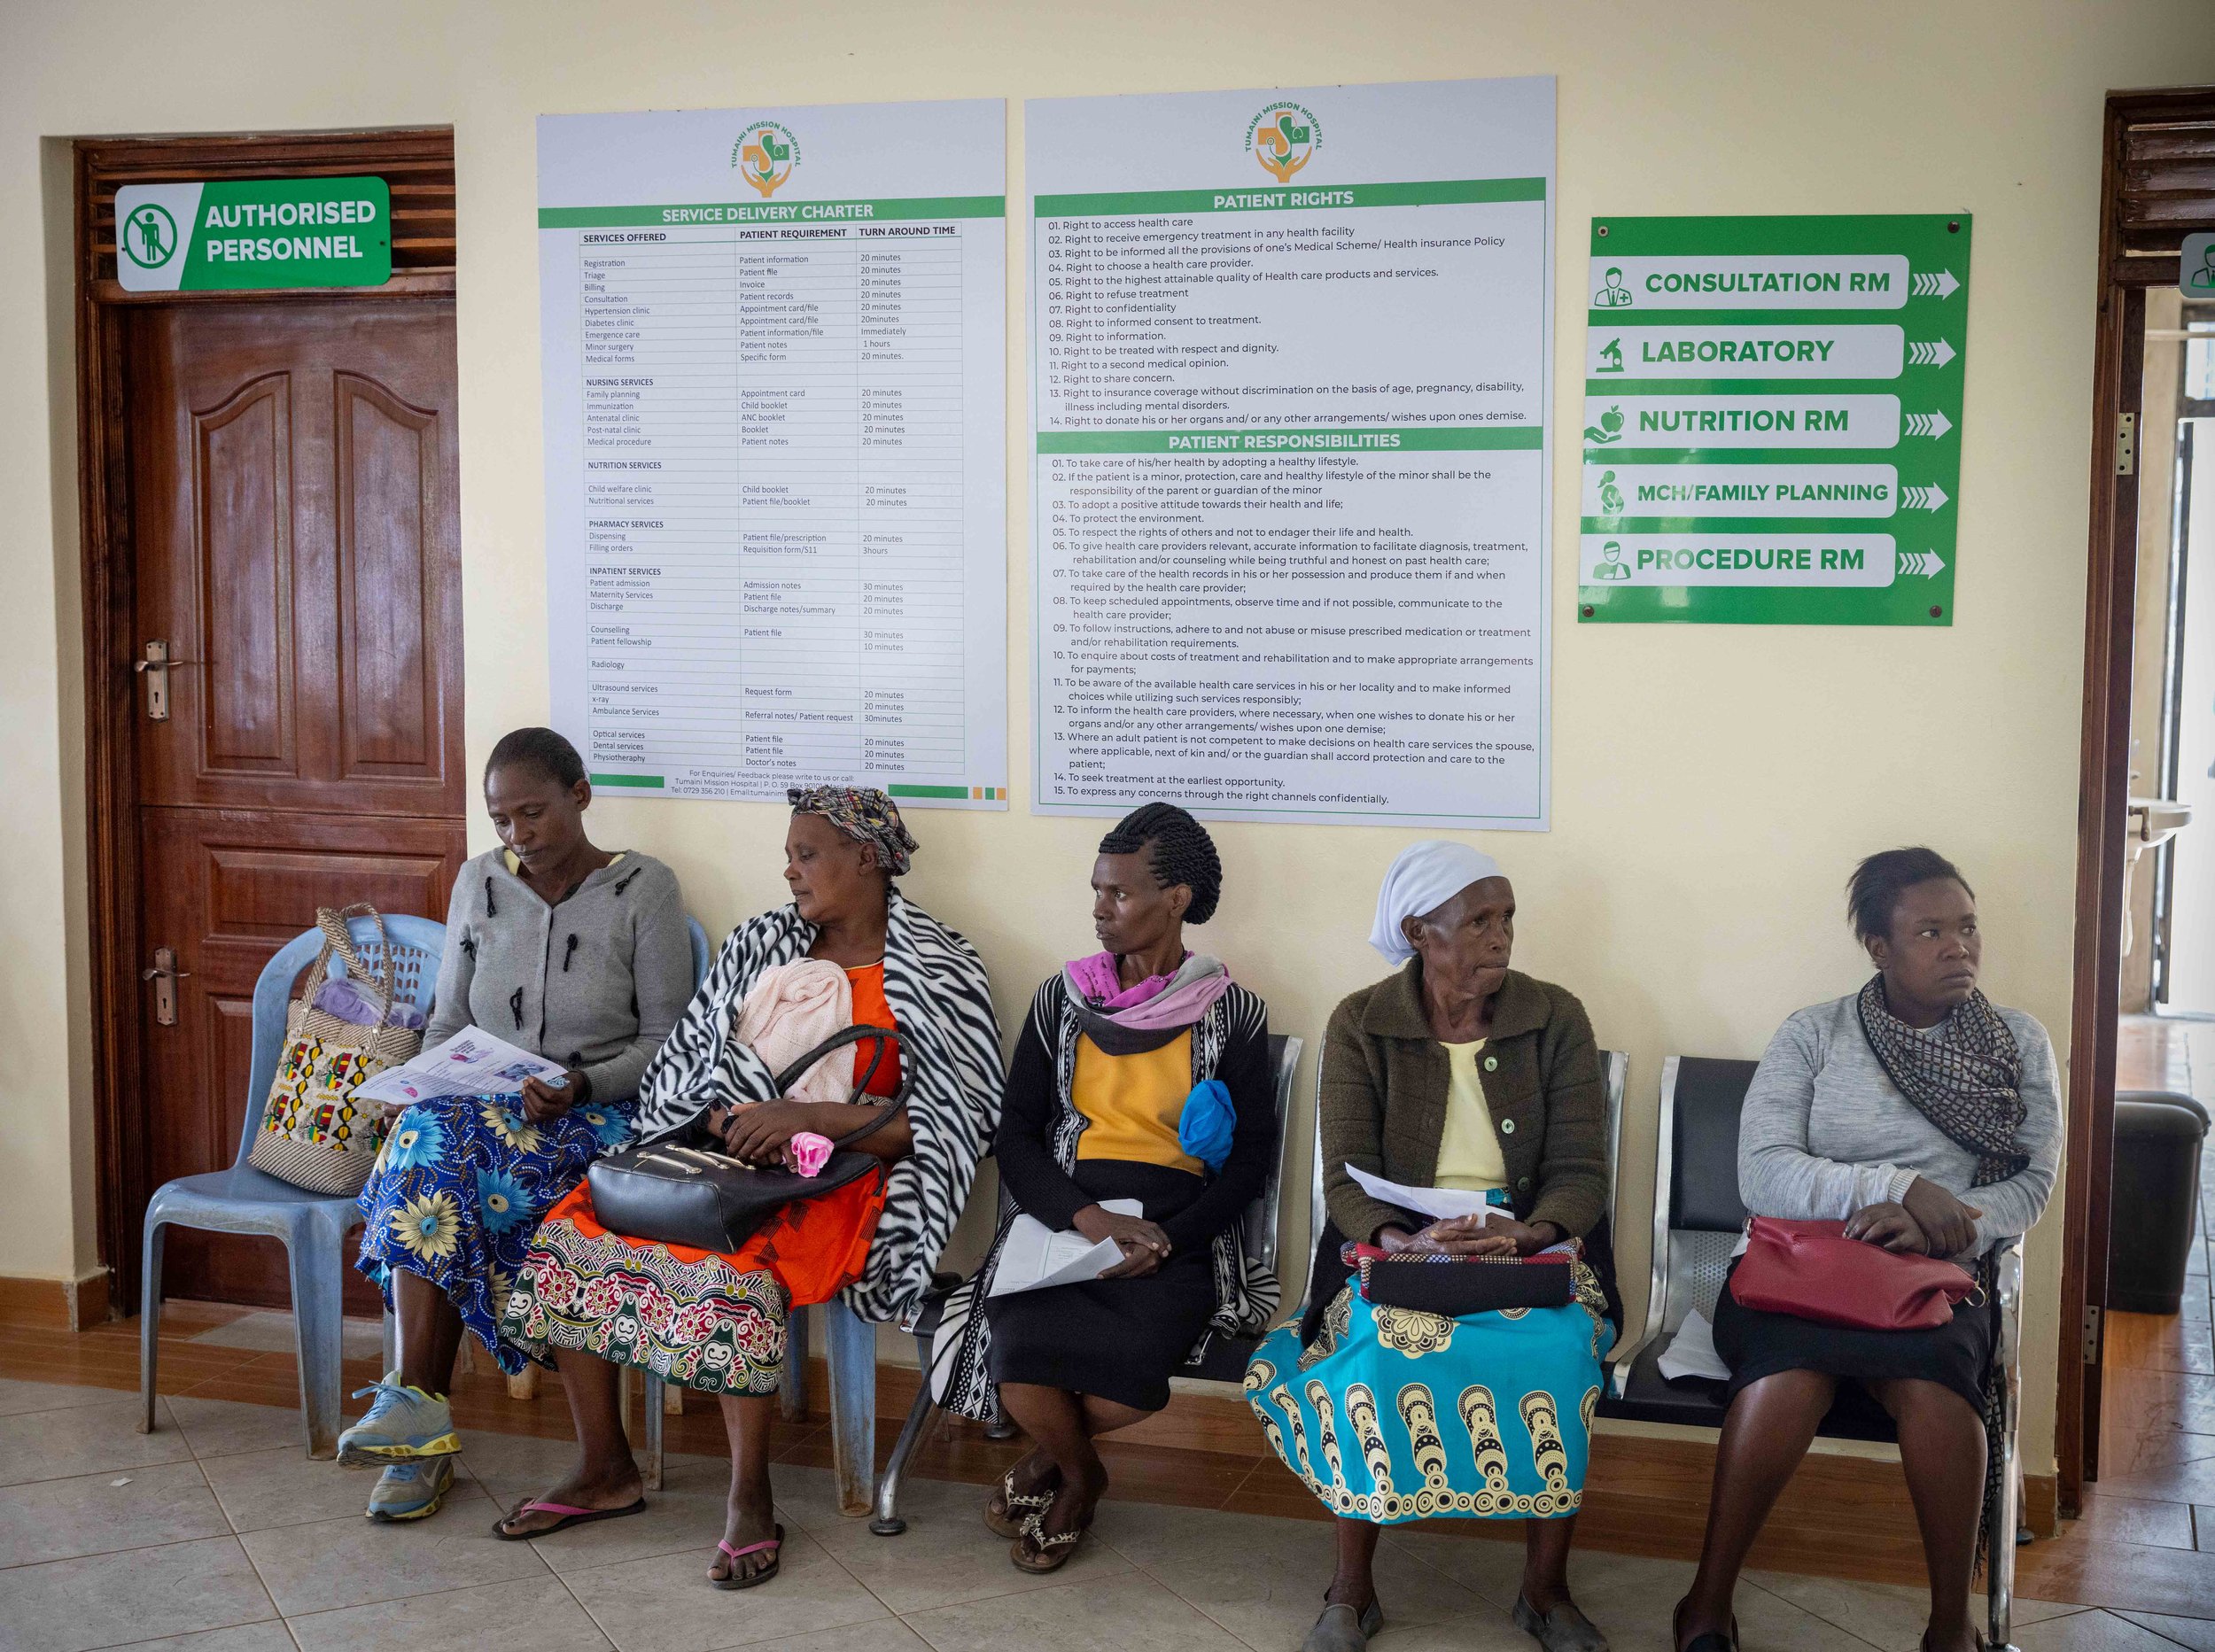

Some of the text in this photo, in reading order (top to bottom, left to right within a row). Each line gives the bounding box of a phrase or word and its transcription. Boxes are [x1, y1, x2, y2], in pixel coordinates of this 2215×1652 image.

[1245, 102, 1323, 152] TUMAINI MISSION HOSPITAL
[731, 120, 801, 168] TUMAINI MISSION HOSPITAL
[1214, 190, 1355, 209] PATIENT RIGHTS
[205, 200, 376, 228] AUTHORISED
[662, 205, 874, 222] SERVICE DELIVERY CHARTER
[1048, 217, 1193, 232] 01. Right to access health care
[740, 228, 847, 240] PATIENT REQUIREMENT
[859, 225, 956, 237] TURN AROUND TIME
[583, 231, 667, 244] SERVICES OFFERED
[206, 236, 363, 262] PERSONNEL
[739, 254, 809, 264] Patient information
[860, 252, 901, 262] 20 minutes
[584, 259, 626, 269] Registration
[860, 265, 901, 275] 20 minutes
[584, 270, 606, 282] Triage
[1048, 267, 1439, 288] 05. Right to the highest attainable quality of Health care products and services.
[1645, 273, 1890, 293] CONSULTATION RM
[584, 294, 628, 303] Consultation
[740, 291, 794, 301] Patient records
[1048, 288, 1189, 302] 06. Right to refuse treatment
[585, 306, 650, 316] Hypertension clinic
[1048, 301, 1177, 316] 07. Right to confidentiality
[860, 326, 907, 337] Immediately
[1049, 330, 1167, 344] 09. Right to information.
[585, 342, 634, 353] Minor surgery
[740, 340, 788, 349] Patient notes
[863, 338, 891, 348] 1 hours
[1642, 340, 1835, 362] LABORATORY
[586, 377, 654, 386] NURSING SERVICES
[1049, 373, 1175, 386] 12. Right to share concern.
[587, 401, 634, 410] Immunization
[760, 400, 788, 410] booklet
[741, 412, 786, 422] ANC booklet
[1639, 410, 1849, 431] NUTRITION RM
[1169, 434, 1401, 449] PATIENT RESPONSIBILITIES
[587, 461, 662, 469] NUTRITION SERVICES
[1052, 455, 1359, 469] 01. To take care of his/her health by adopting a healthy lifestyle.
[1637, 485, 1888, 501] MCH/FAMILY PLANNING
[588, 519, 664, 529] PHARMACY SERVICES
[1052, 512, 1205, 524] 04. To protect the environment.
[589, 543, 633, 553] Filling orders
[742, 544, 818, 555] Requisition form/S11
[863, 546, 889, 555] 3hours
[1637, 549, 1864, 570] PROCEDURE RM
[589, 566, 662, 576] INPATIENT SERVICES
[743, 603, 836, 615] Discharge notes/summary
[591, 659, 625, 671] Radiology
[1068, 691, 1302, 707] choices while utilizing such services responsibly;
[593, 752, 646, 764] Physiotheraphy
[702, 770, 736, 780] Enquiries/
[737, 771, 771, 779] Feedback
[772, 772, 796, 781] please
[1053, 772, 1286, 789] 14. To seek treatment at the earliest opportunity.
